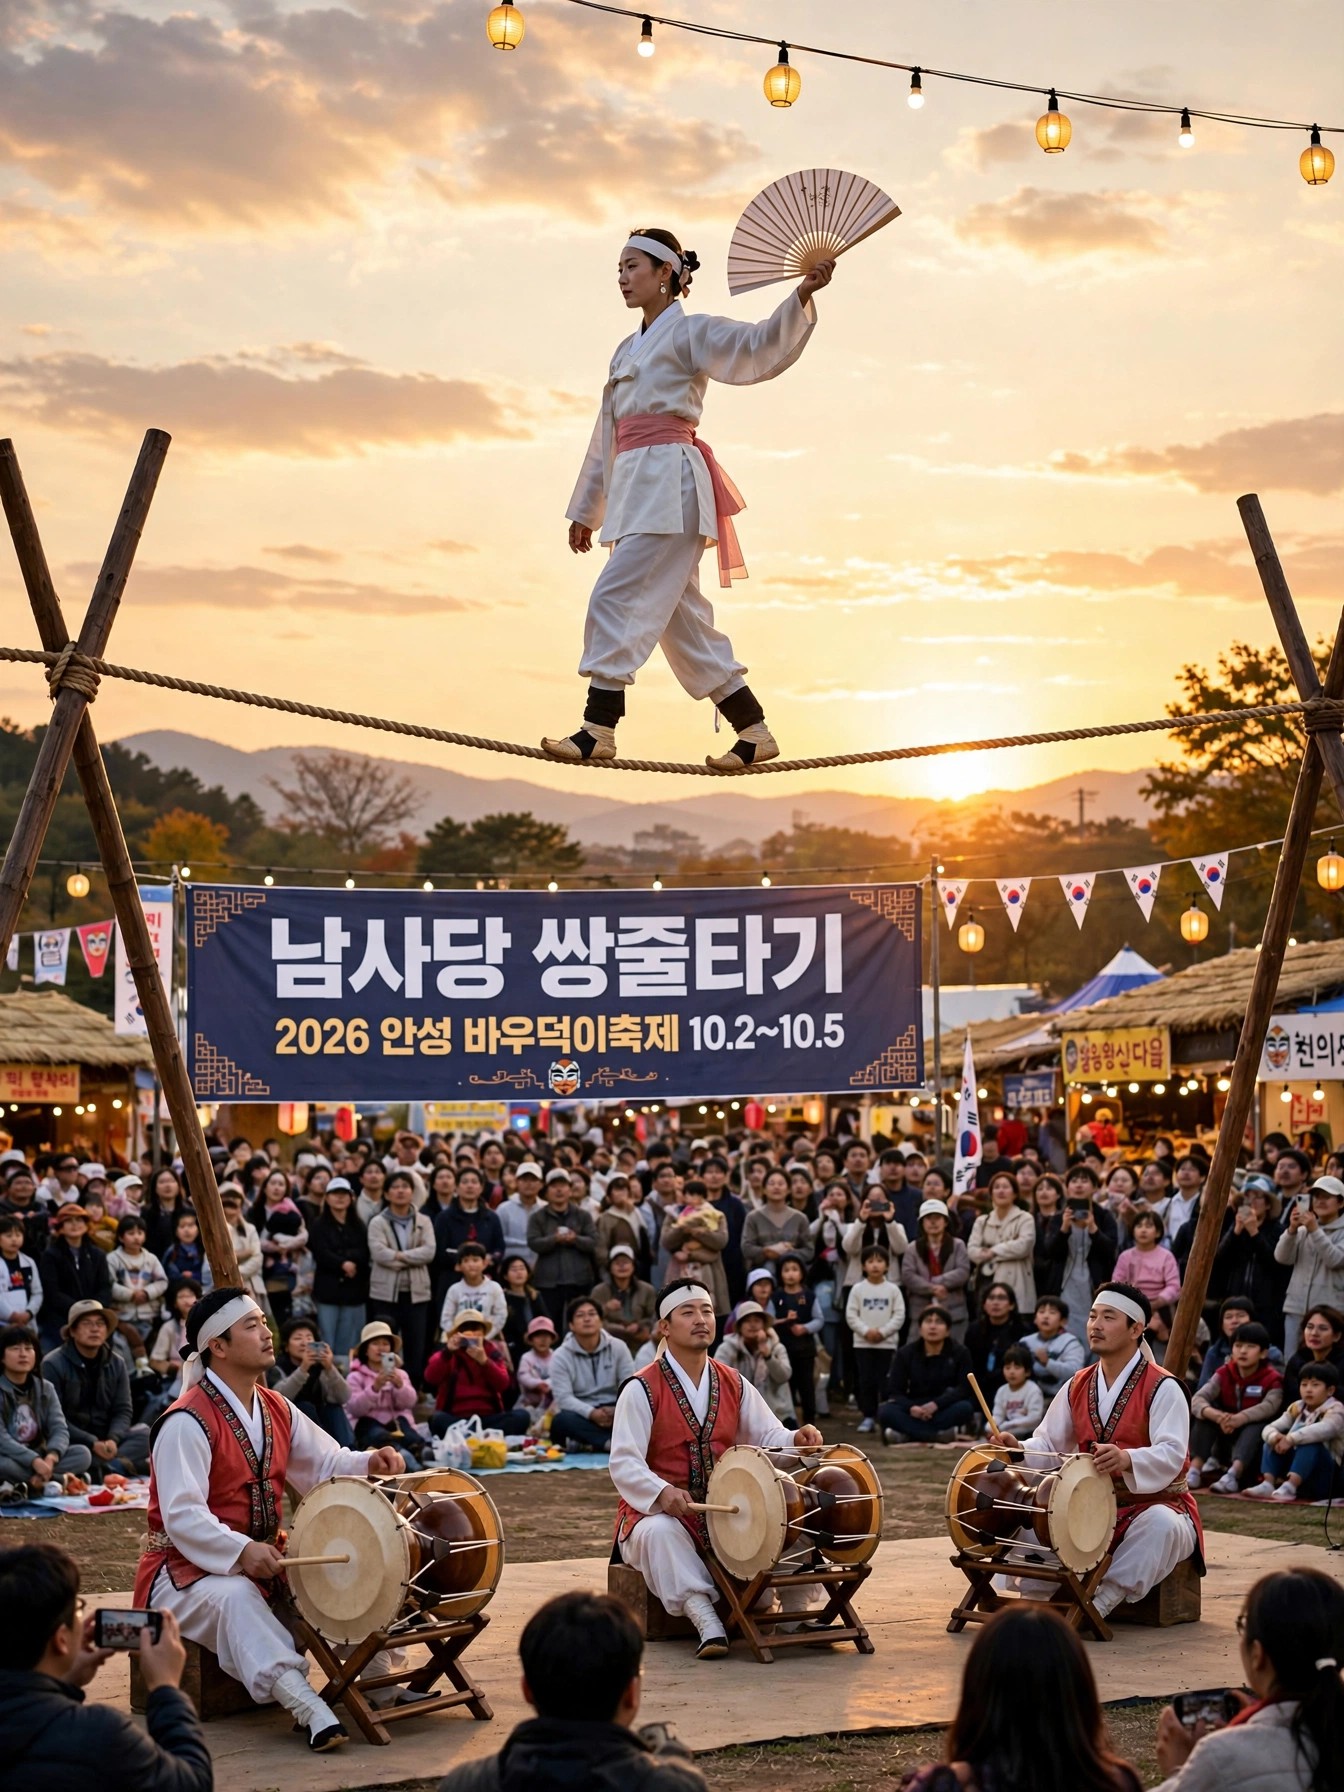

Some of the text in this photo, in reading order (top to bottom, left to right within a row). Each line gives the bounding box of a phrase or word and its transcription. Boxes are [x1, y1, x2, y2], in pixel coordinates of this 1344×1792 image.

[271, 912, 843, 999] 남사당 쌍줄타기
[275, 1012, 845, 1056] 2026 안성 바우덕이축제 10.2~10.5
